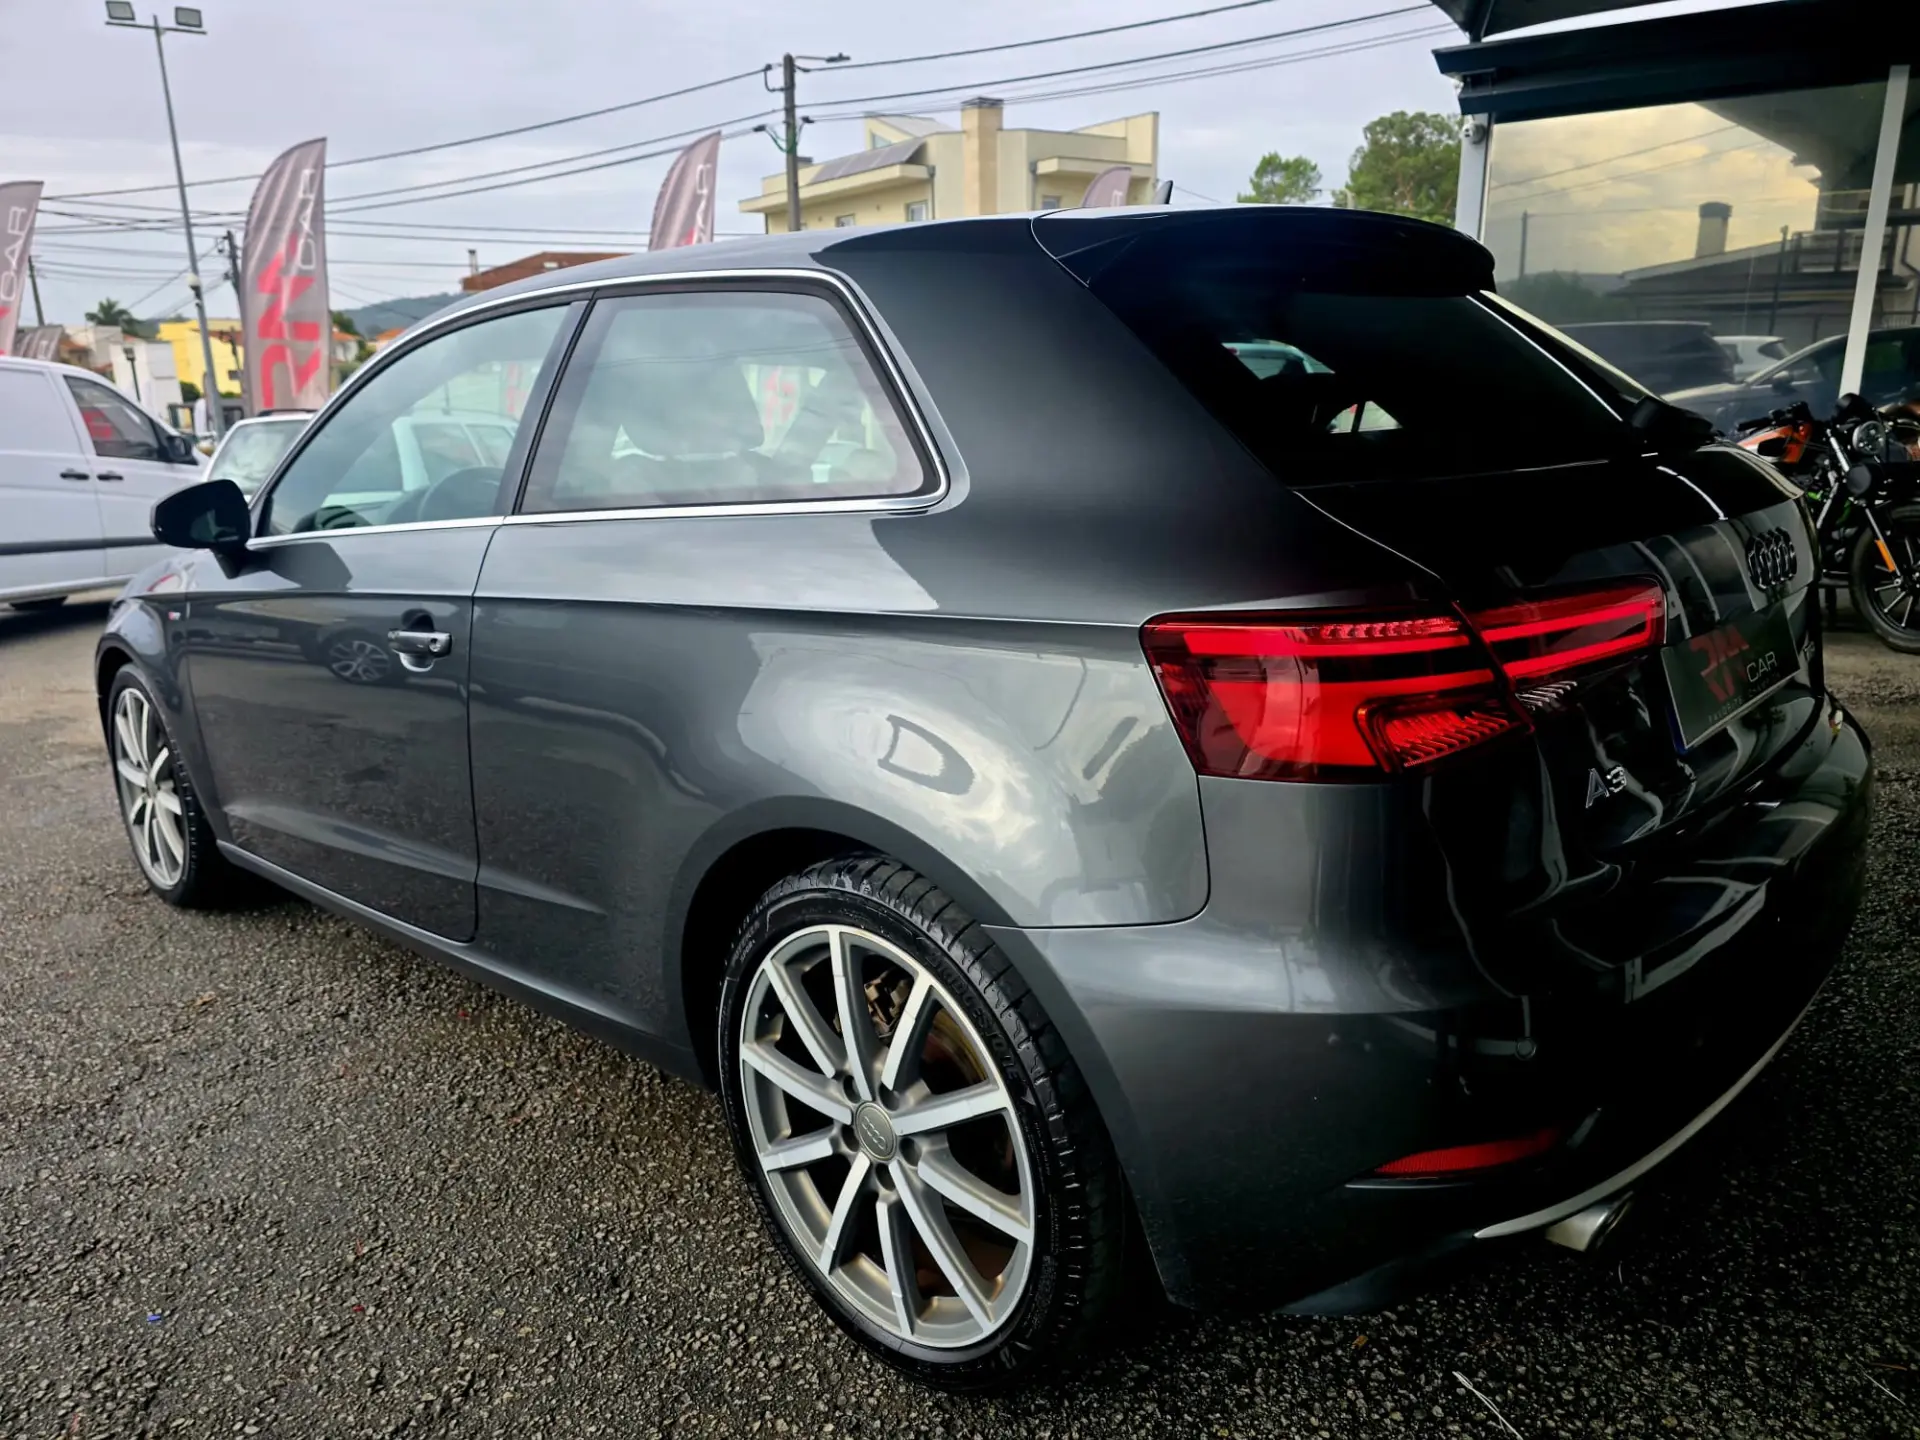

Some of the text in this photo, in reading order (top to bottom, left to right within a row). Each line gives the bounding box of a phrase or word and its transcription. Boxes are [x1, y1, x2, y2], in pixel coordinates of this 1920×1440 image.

[1, 206, 28, 301] CAR
[299, 168, 316, 270] CAR
[1746, 651, 1778, 683] CAR
[1585, 766, 1627, 809] A3
